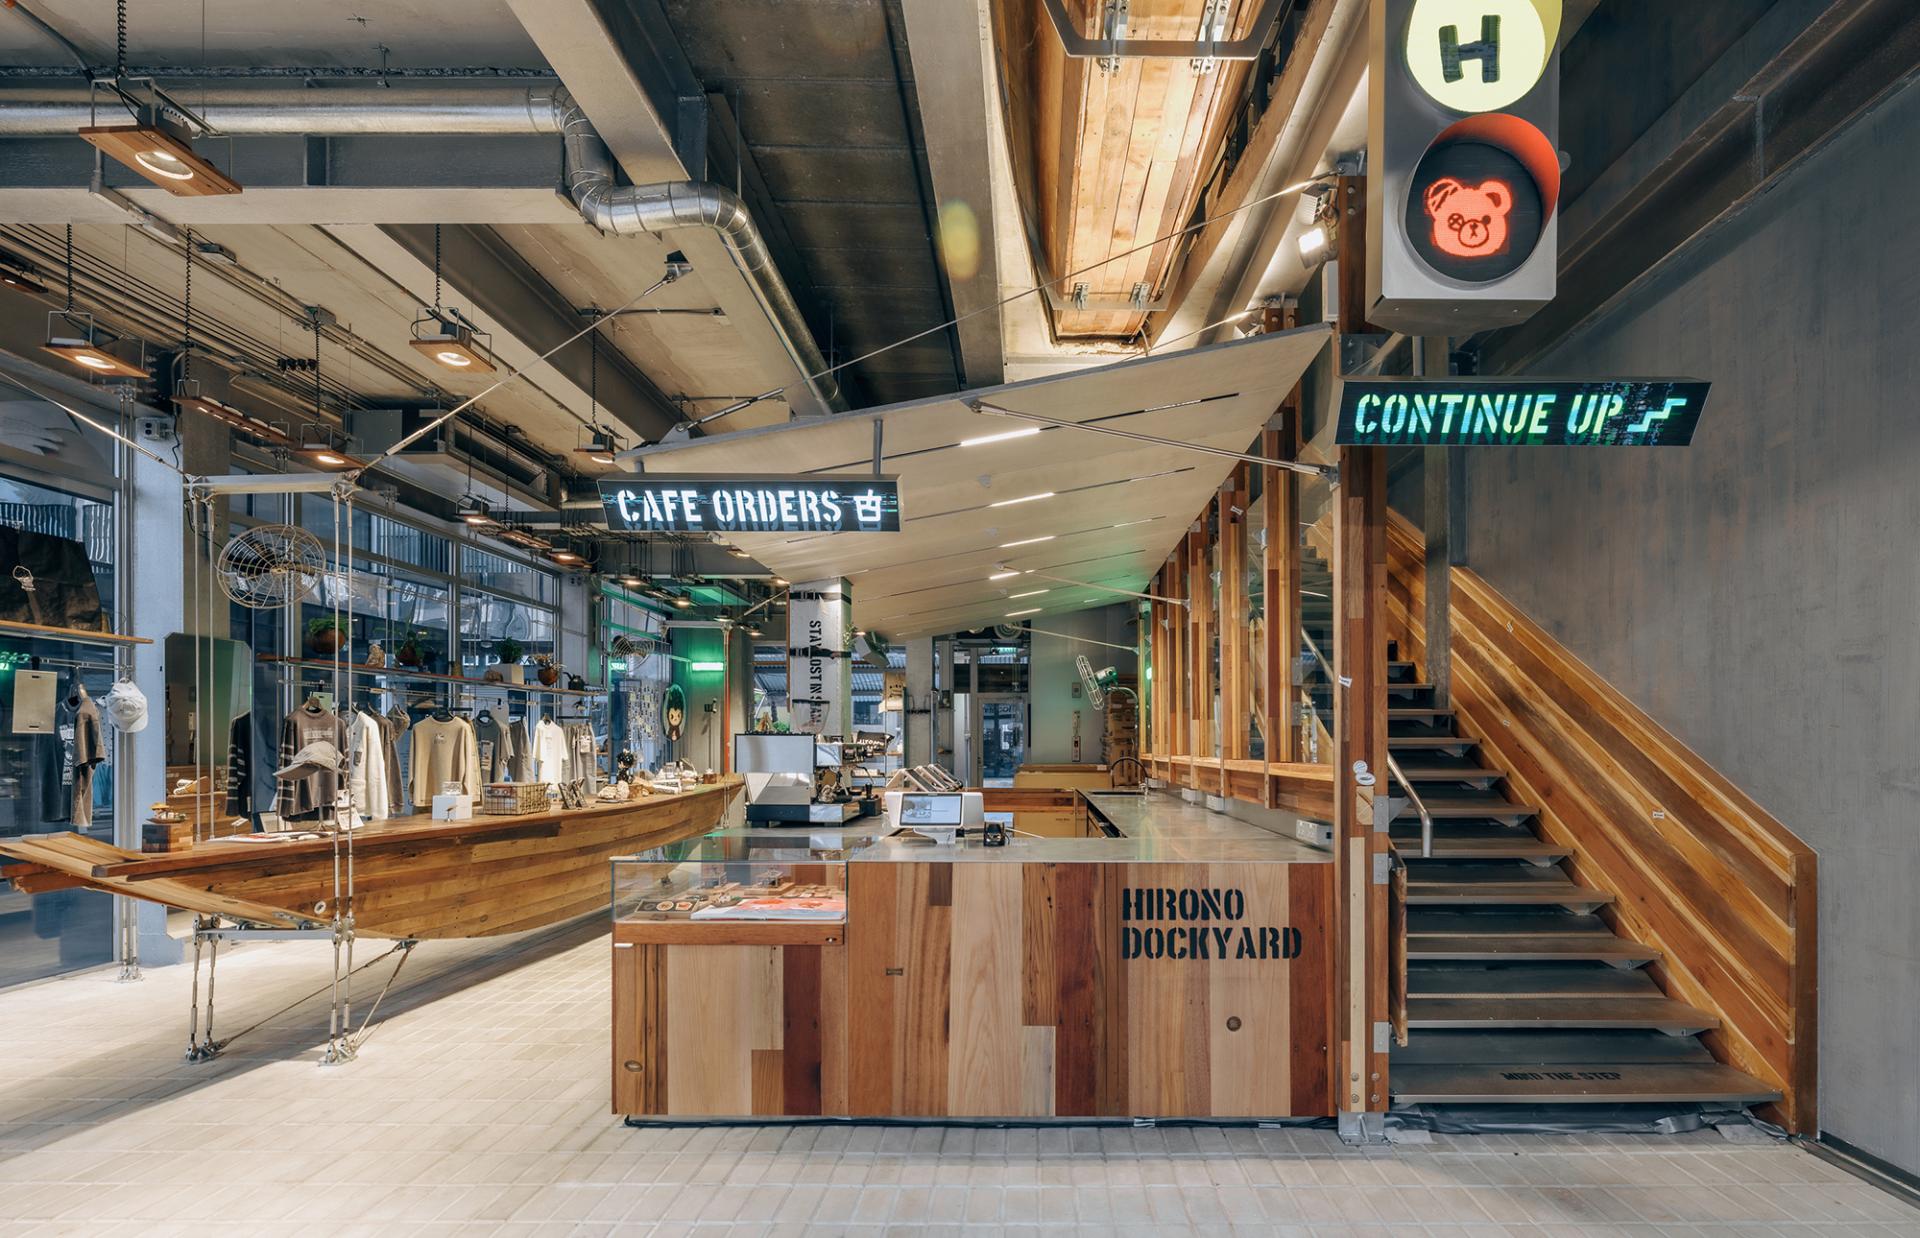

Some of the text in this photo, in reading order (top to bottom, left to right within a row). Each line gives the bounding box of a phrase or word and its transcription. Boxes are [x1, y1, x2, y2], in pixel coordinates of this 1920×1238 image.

[1438, 14, 1501, 83] H
[1354, 394, 1624, 434] CONTINUE UP
[615, 489, 842, 522] CAFE ORDERS
[1122, 888, 1245, 920] HIRONO
[1122, 927, 1302, 959] DOCKYARD
